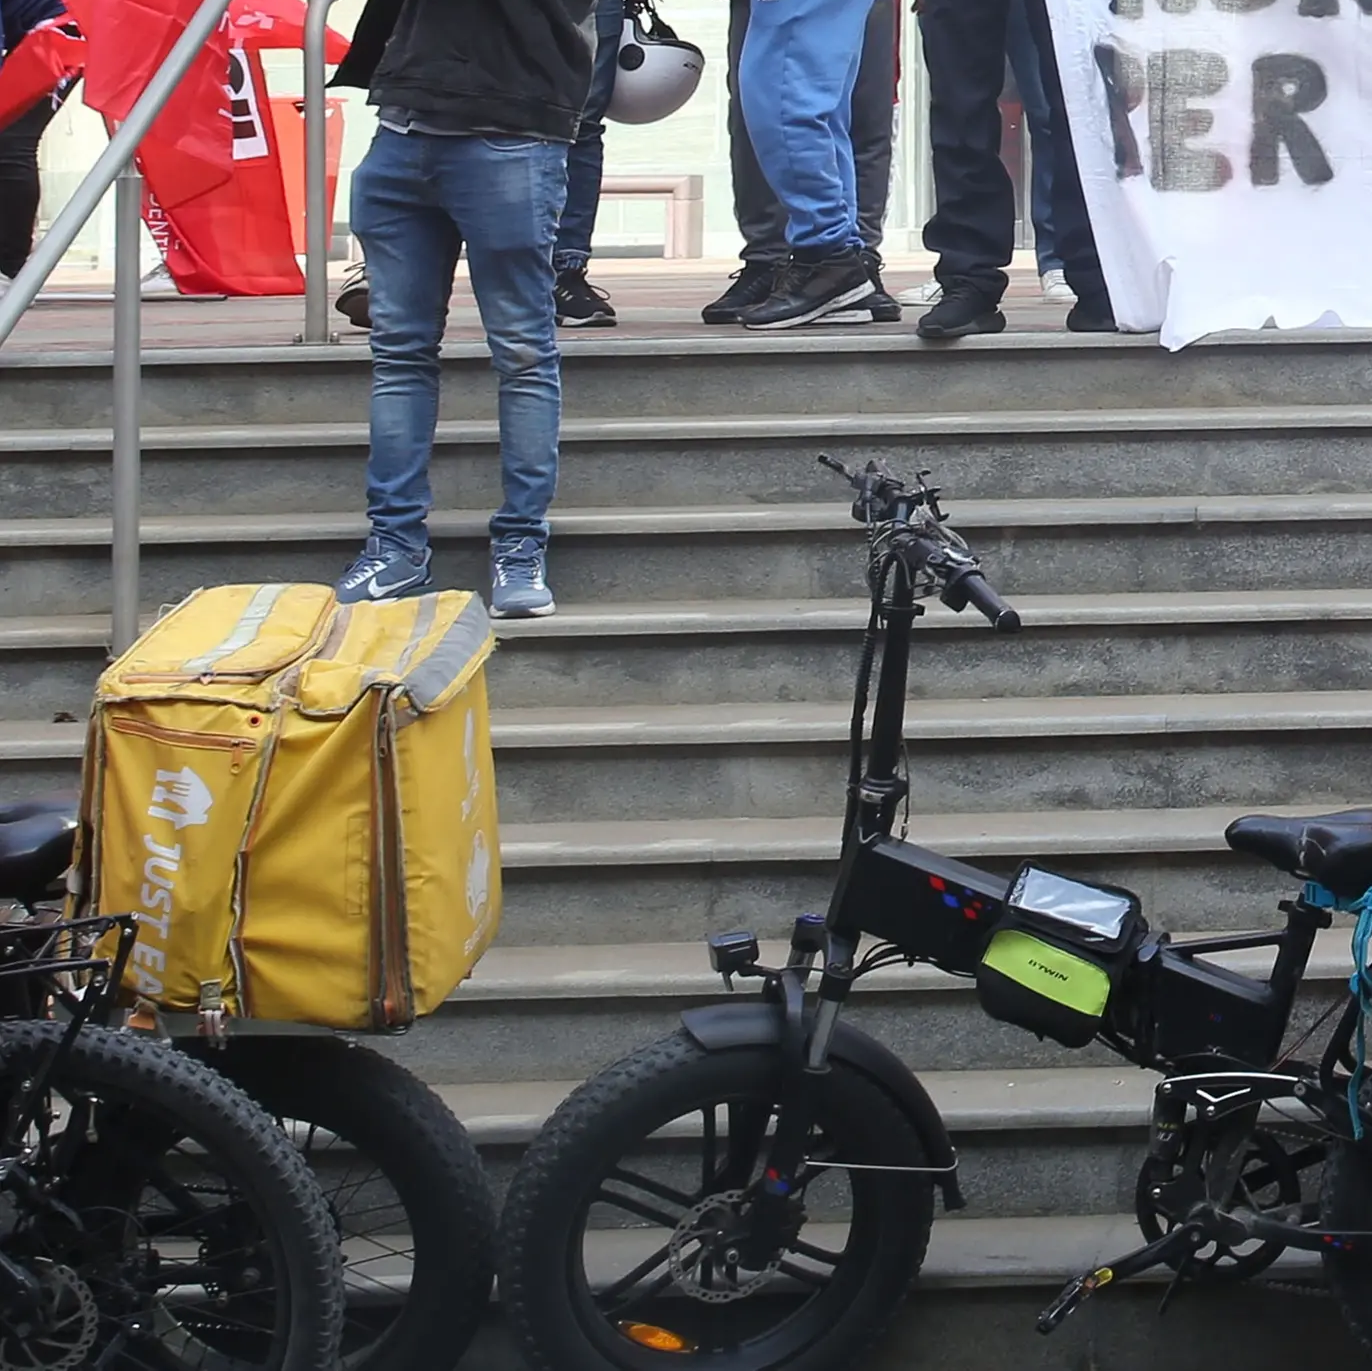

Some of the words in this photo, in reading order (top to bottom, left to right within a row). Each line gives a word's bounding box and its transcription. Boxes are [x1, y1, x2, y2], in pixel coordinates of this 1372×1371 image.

[1095, 44, 1335, 193] PER
[139, 834, 181, 940] JUST
[134, 941, 165, 995] EA
